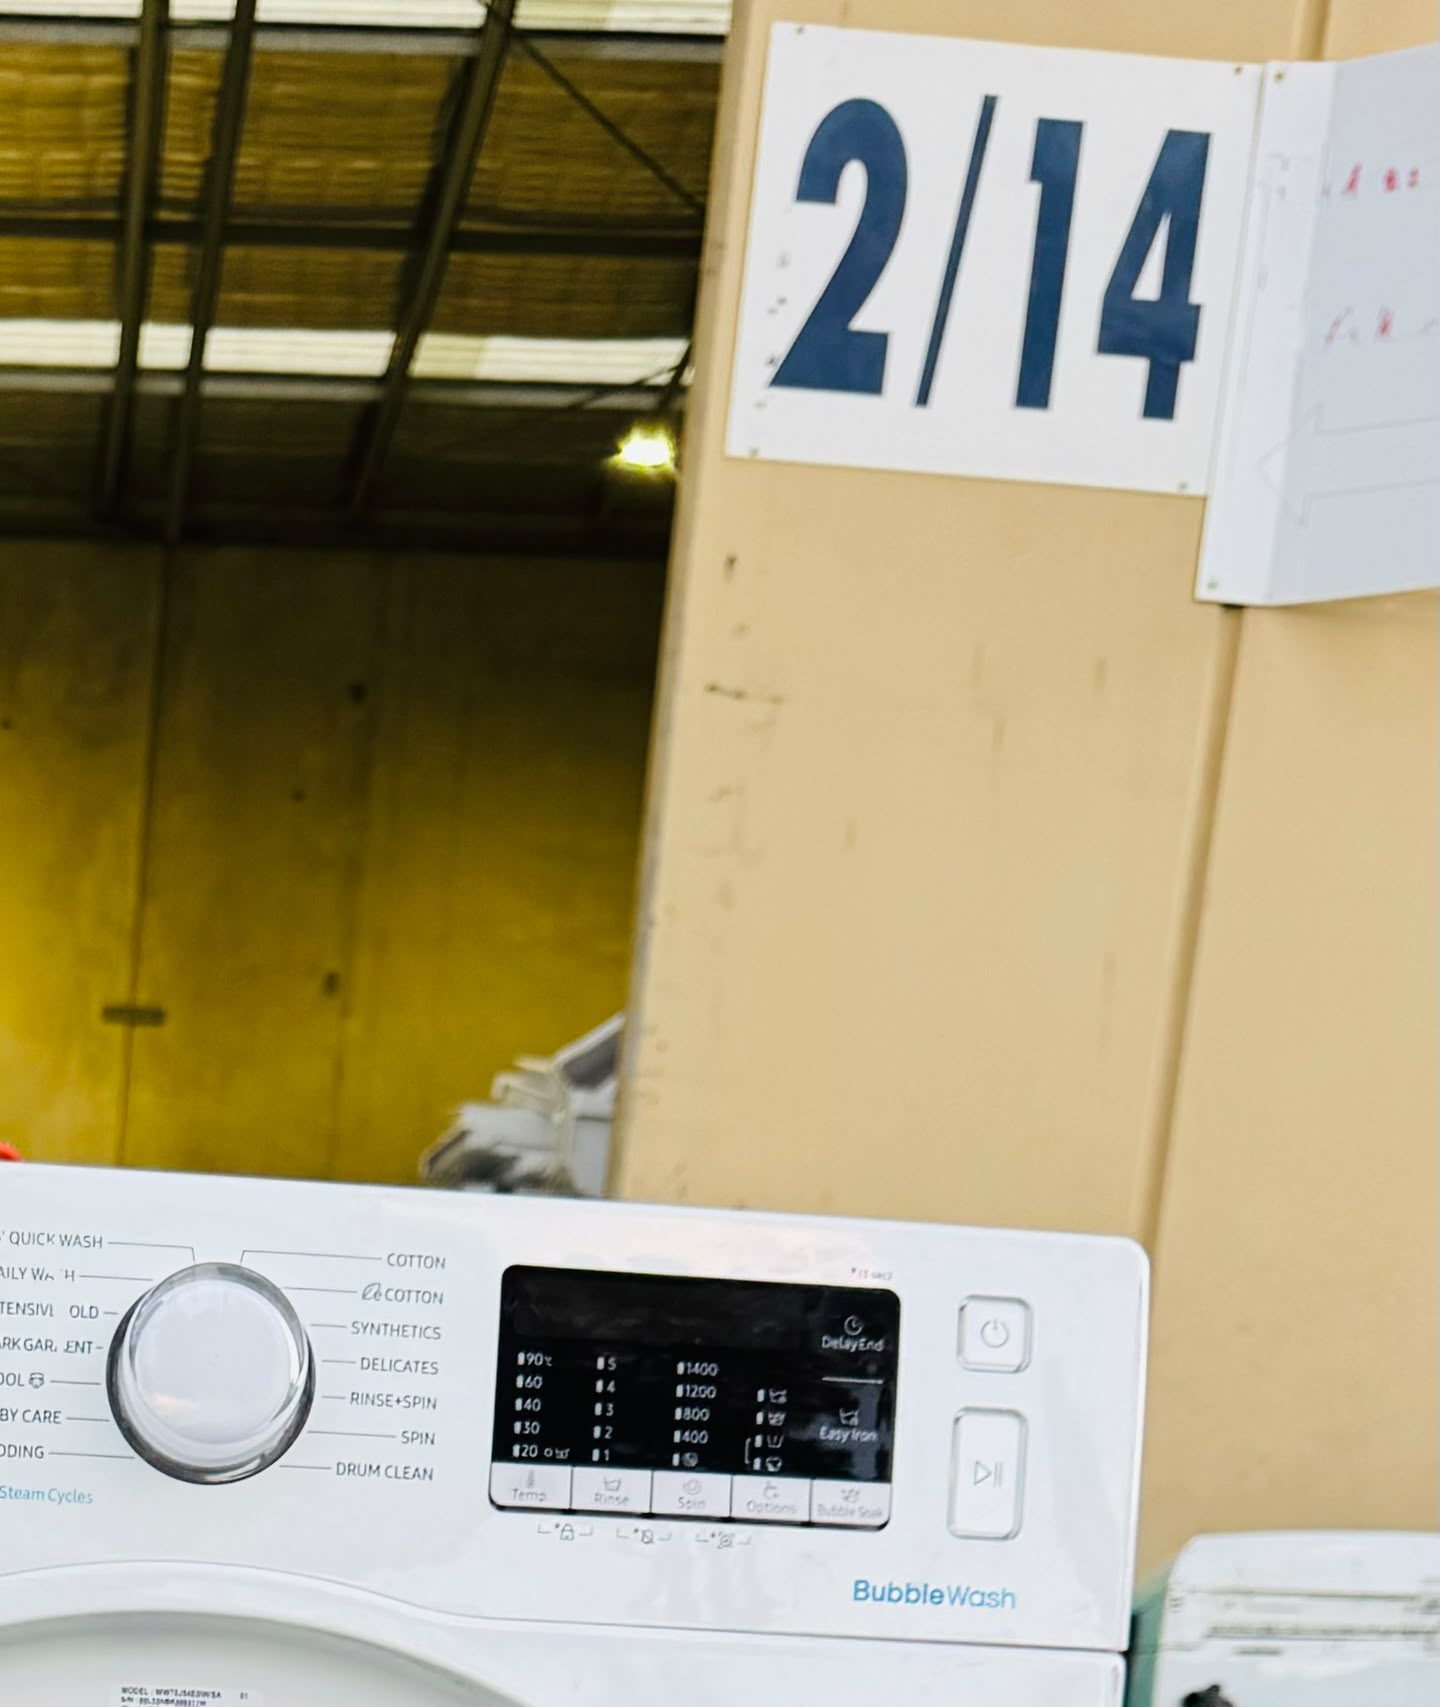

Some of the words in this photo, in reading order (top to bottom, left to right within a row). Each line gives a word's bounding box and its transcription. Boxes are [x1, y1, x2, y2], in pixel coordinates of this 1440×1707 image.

[769, 94, 1211, 420] 2/14
[9, 1230, 56, 1246] QUICK
[58, 1233, 104, 1249] WASH
[386, 1252, 447, 1270] COTTON
[384, 1287, 444, 1305] COTTON
[69, 1304, 99, 1319] OLD
[350, 1320, 442, 1340] SYNTHETICS
[23, 1337, 94, 1355] GARENT
[360, 1356, 439, 1376] DELICATES
[607, 1356, 617, 1371] 5
[685, 1361, 720, 1377] 1400
[524, 1375, 543, 1389] 60
[606, 1380, 616, 1393] 4
[685, 1384, 717, 1399] 1200
[350, 1391, 438, 1411] RINSE+SPIN
[523, 1397, 542, 1412] 40
[22, 1408, 62, 1424] CARE
[605, 1402, 615, 1417] 3
[682, 1407, 710, 1421] 800
[522, 1421, 540, 1435] 30
[603, 1425, 614, 1439] 2
[401, 1430, 436, 1445] SPIN
[681, 1429, 709, 1444] 400
[521, 1444, 539, 1458] 20
[336, 1461, 381, 1478] DRUM
[384, 1464, 435, 1481] CLEAN
[47, 1487, 94, 1506] Cycles
